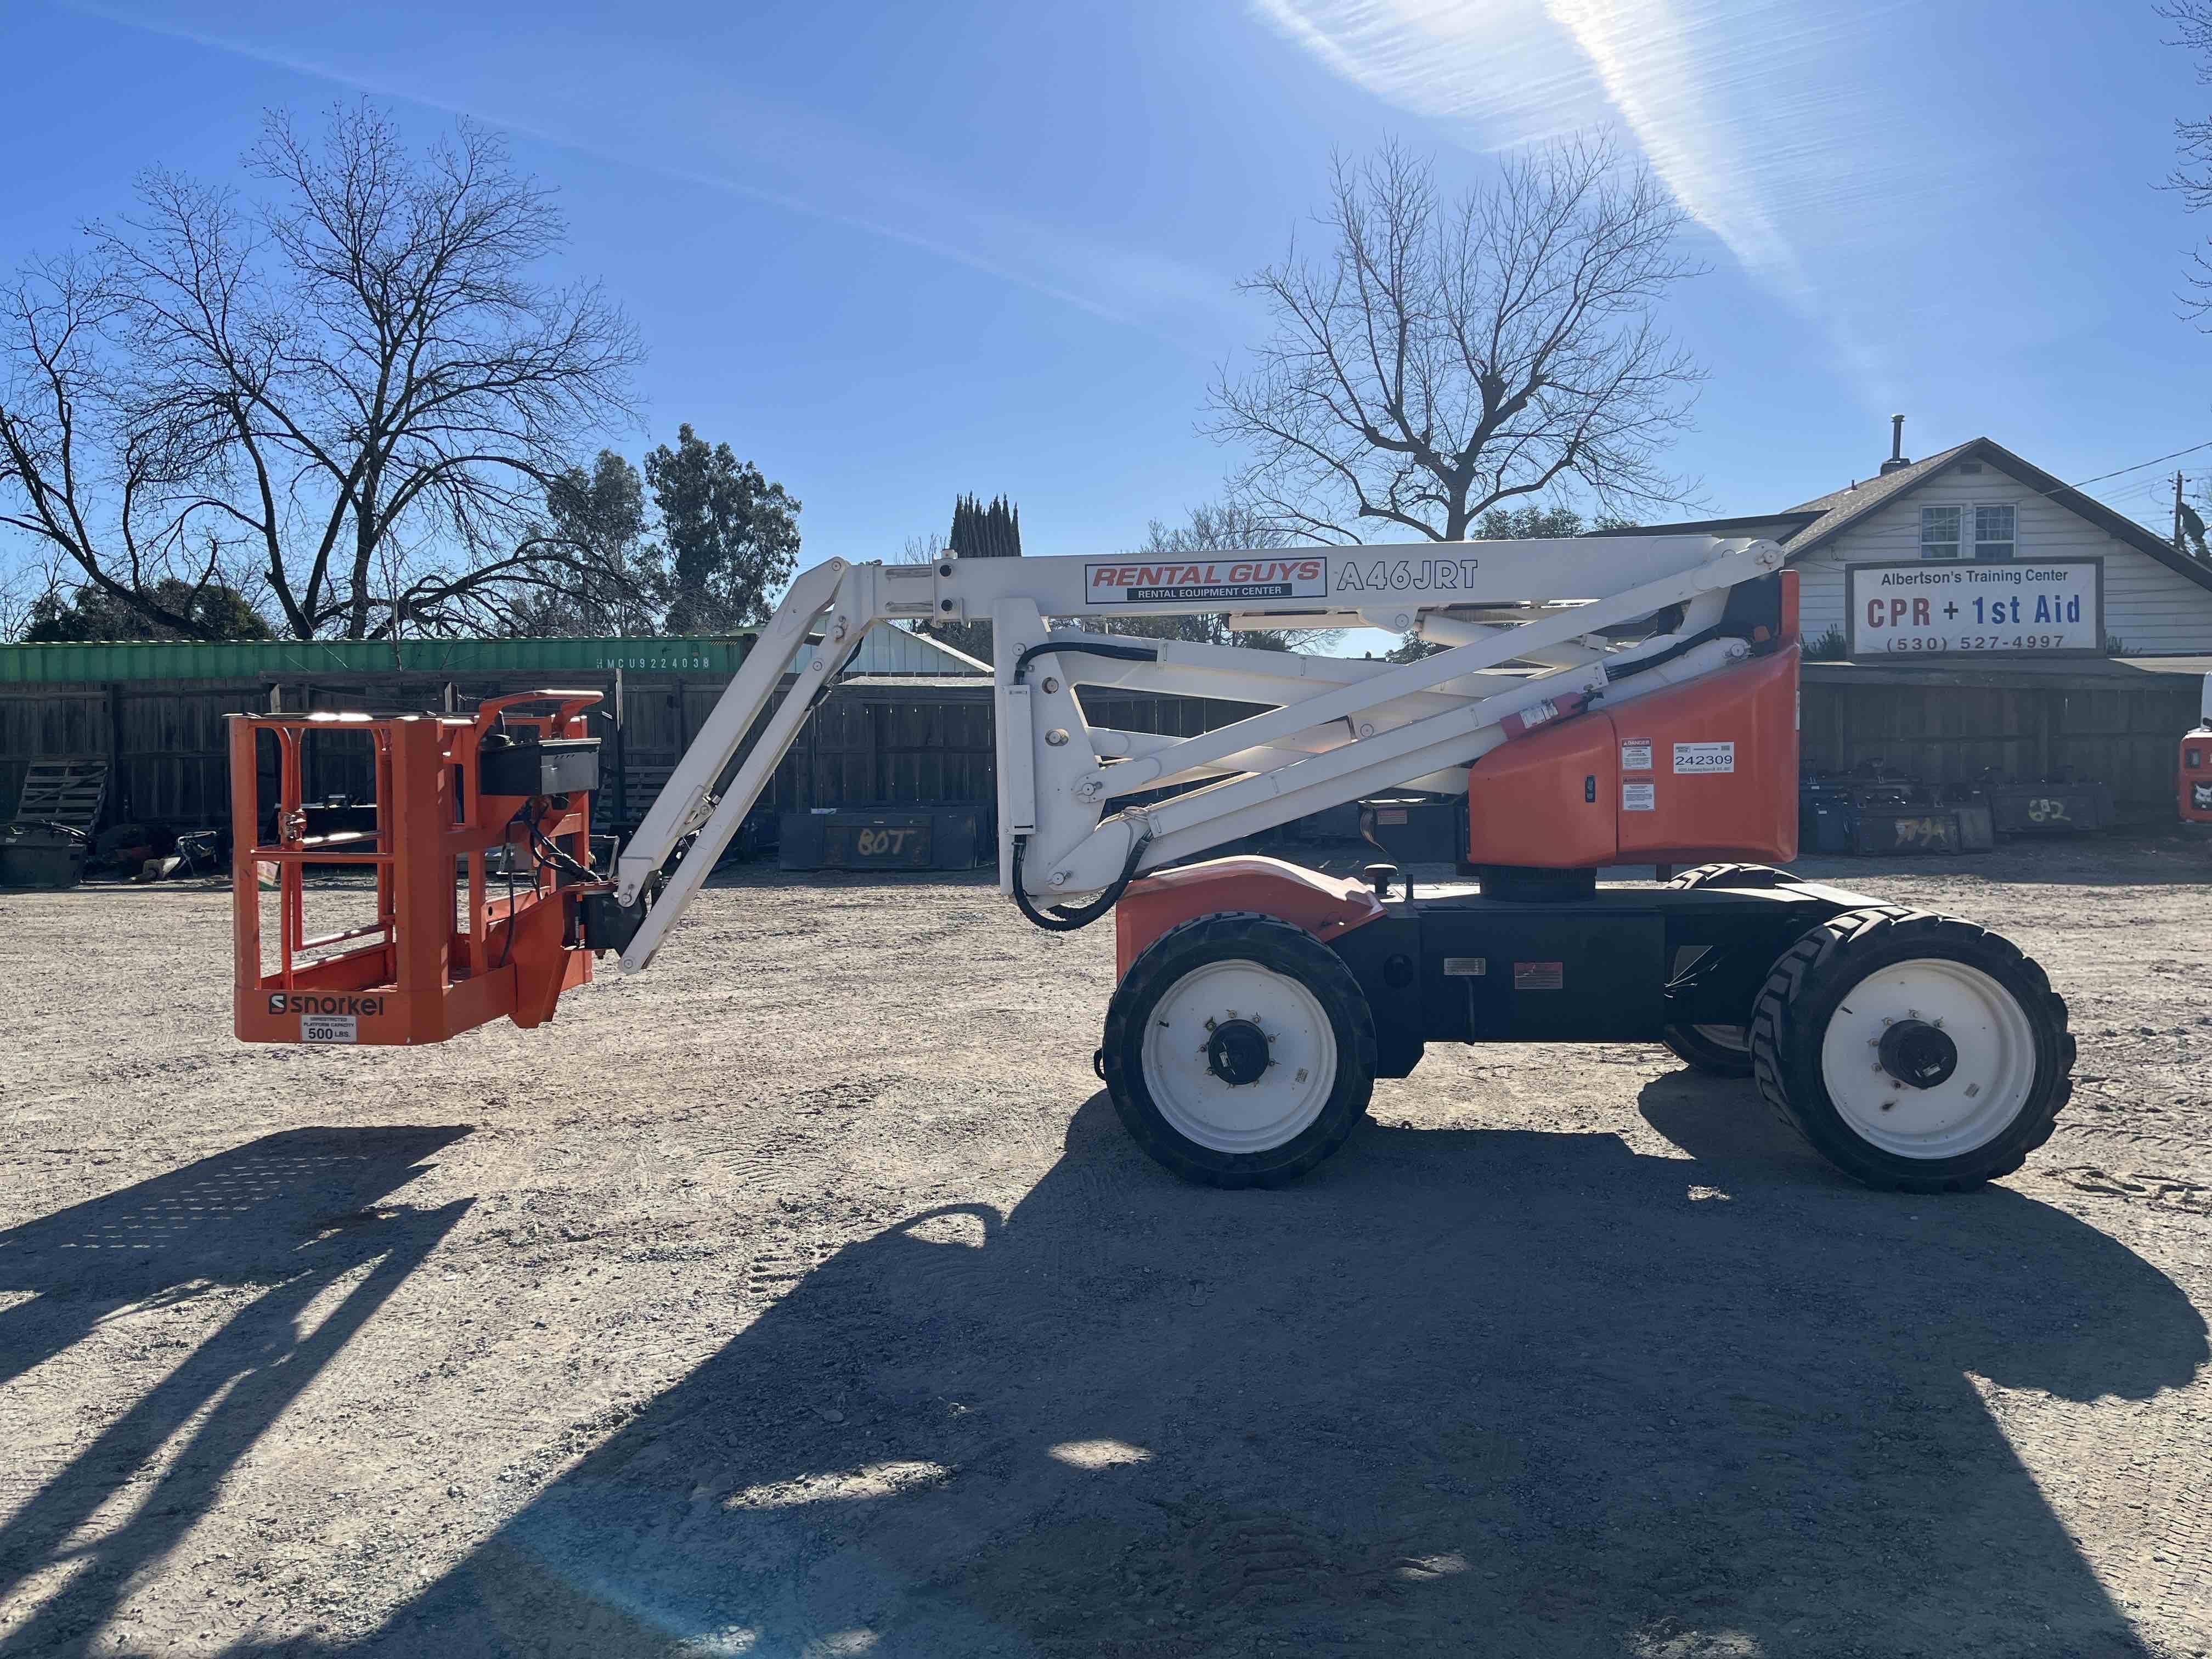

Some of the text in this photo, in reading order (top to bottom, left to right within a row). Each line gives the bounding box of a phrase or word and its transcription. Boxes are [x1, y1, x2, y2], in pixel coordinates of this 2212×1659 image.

[1093, 562, 1321, 587] RENTAL GUYS
[1336, 559, 1478, 591] A46JRT
[1881, 569, 2068, 586] Albertson's Training Center
[1138, 586, 1282, 598] RENTAL EQUIPMENT CENTER
[1867, 598, 1931, 628] CPR
[1972, 596, 2020, 624] 1st
[2034, 595, 2080, 623] Aid
[1887, 635, 2064, 652] (530) 527-4997
[1675, 755, 1733, 765] 242309
[290, 996, 384, 1015] snorkel
[308, 1029, 332, 1039] 500
